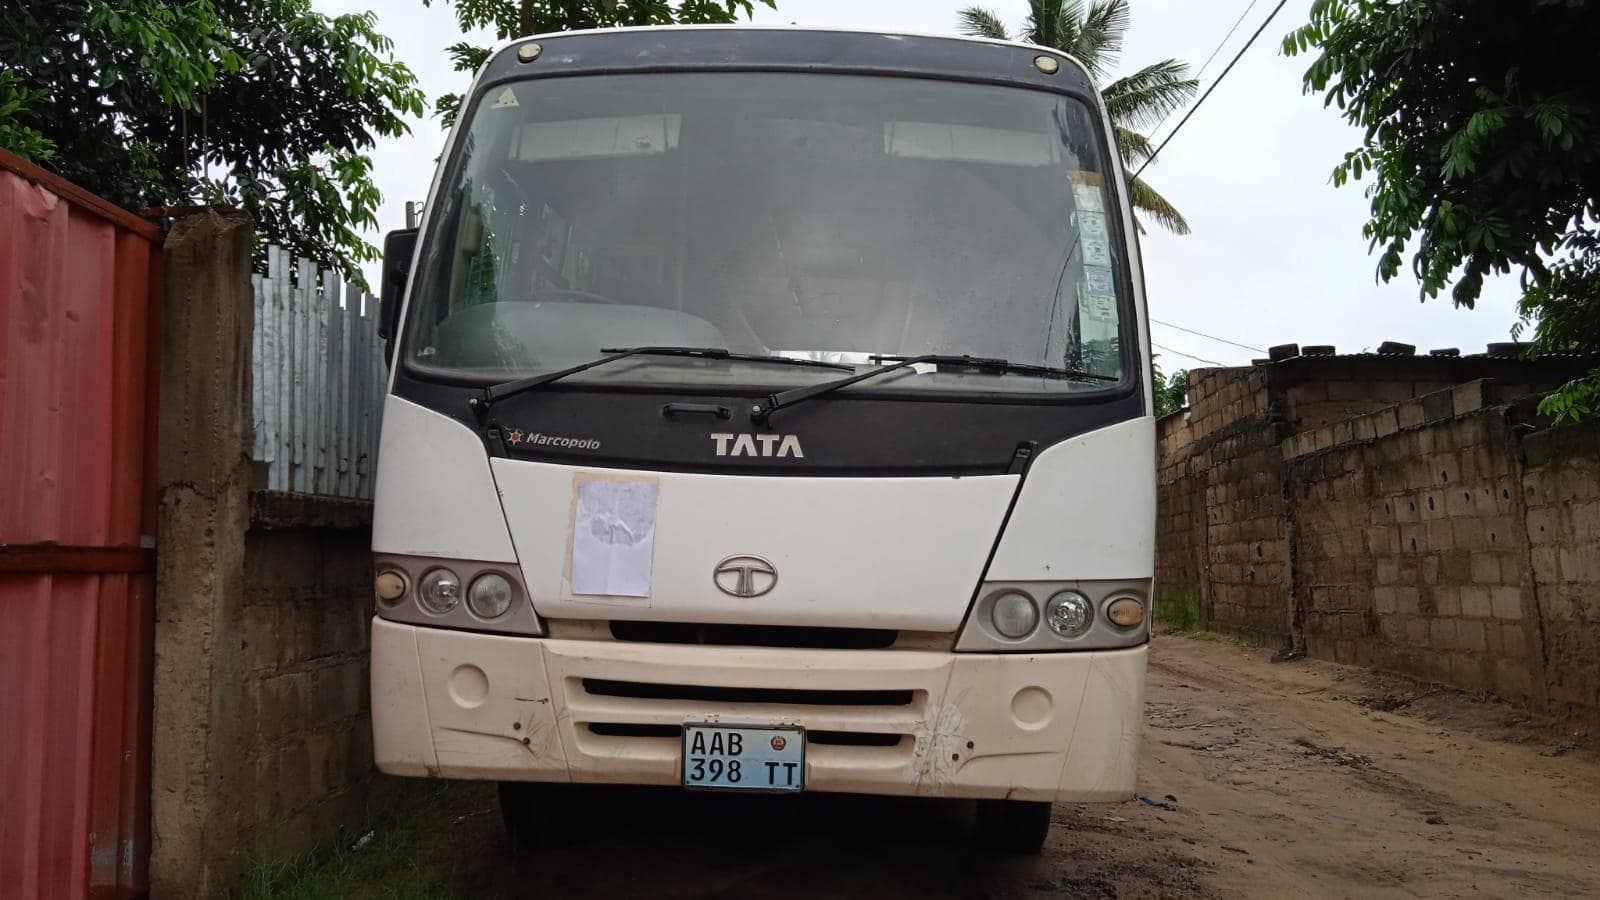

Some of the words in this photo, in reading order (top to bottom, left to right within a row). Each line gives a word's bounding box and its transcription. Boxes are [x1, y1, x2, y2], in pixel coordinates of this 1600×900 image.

[526, 432, 601, 450] Marcopolo
[711, 432, 804, 458] TATA
[690, 731, 743, 756] AAB
[690, 758, 742, 783] 398
[764, 761, 798, 785] TT
